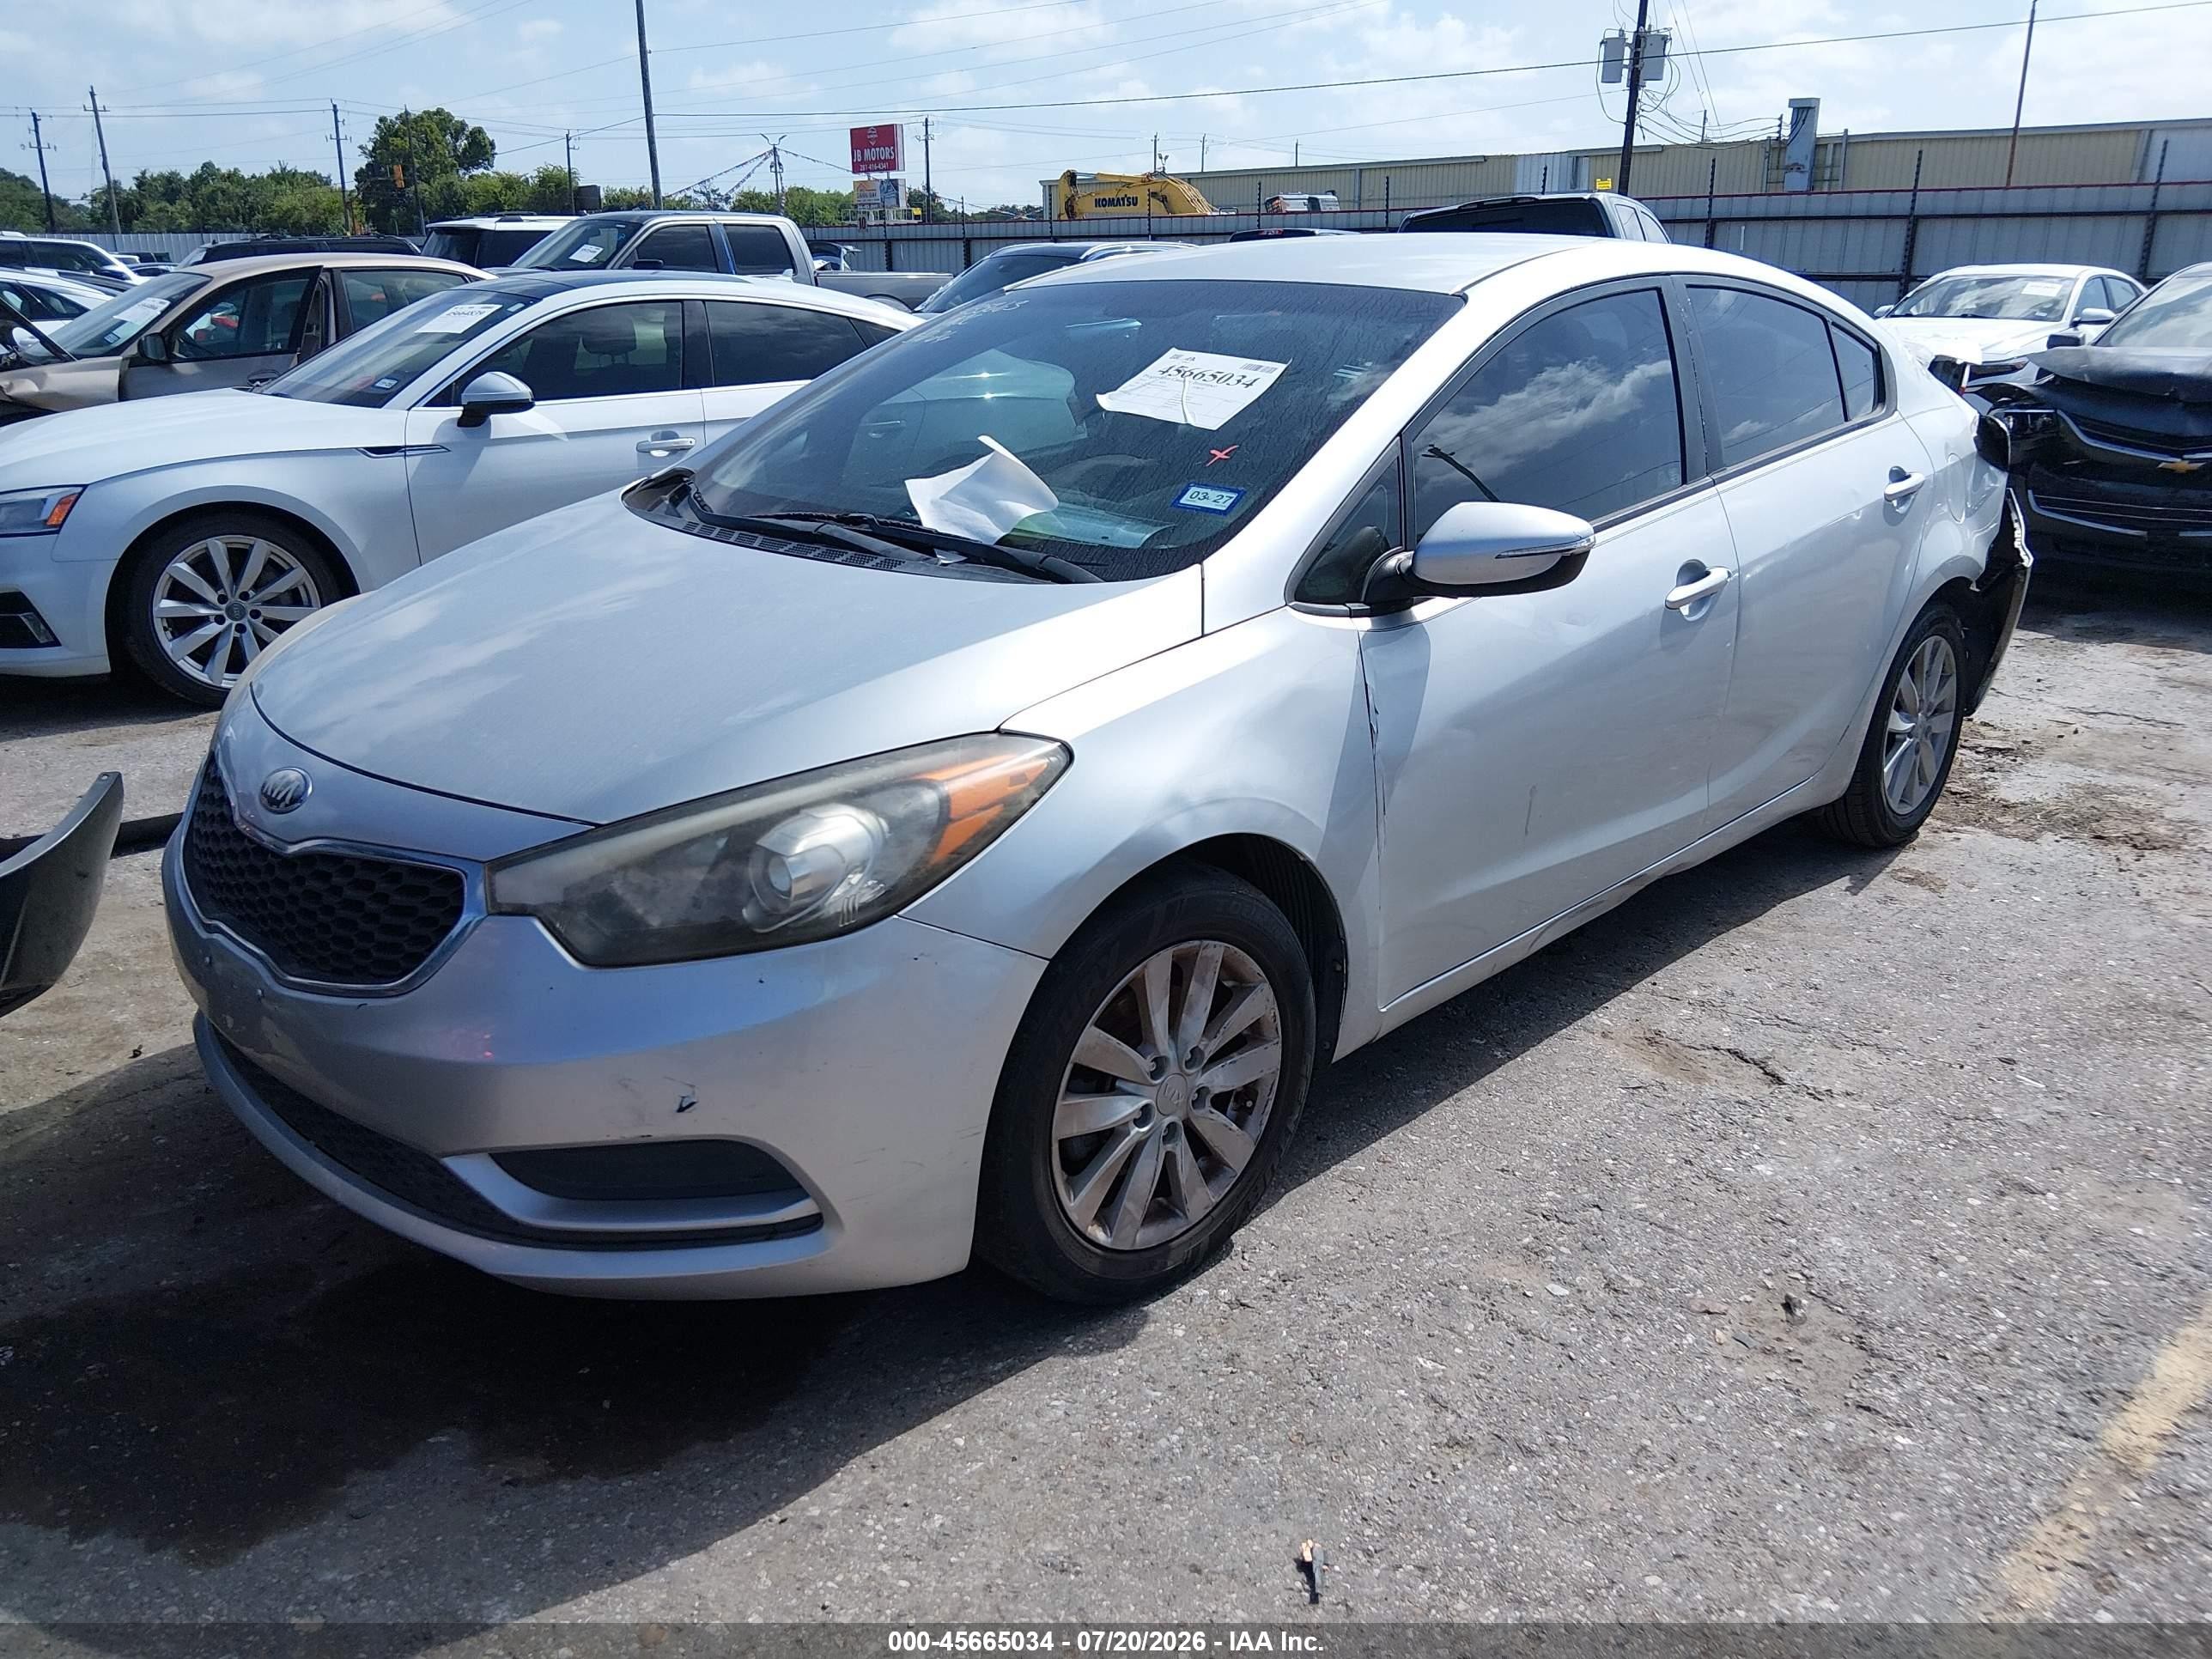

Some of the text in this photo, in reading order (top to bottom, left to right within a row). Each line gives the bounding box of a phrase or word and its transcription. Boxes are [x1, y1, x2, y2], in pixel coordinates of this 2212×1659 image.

[854, 147, 895, 162] JB MOTORS
[1095, 194, 1139, 208] KOMATSU
[1158, 364, 1261, 389] 45665034
[1189, 490, 1235, 504] 03 27
